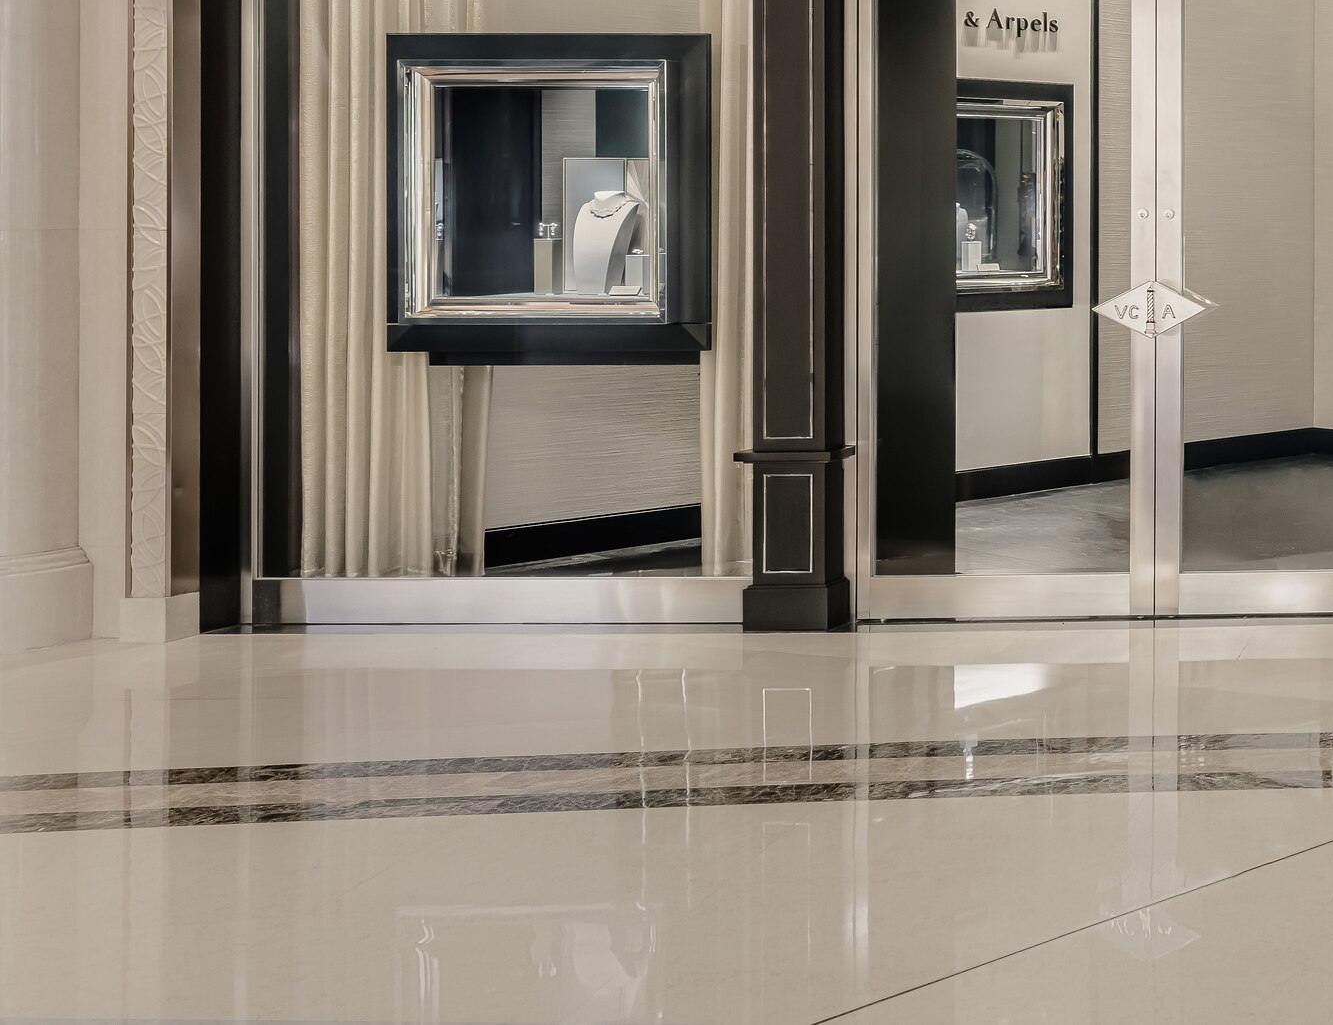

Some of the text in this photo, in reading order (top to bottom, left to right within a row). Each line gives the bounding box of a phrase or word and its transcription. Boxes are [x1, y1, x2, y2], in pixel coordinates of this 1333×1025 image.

[963, 8, 1059, 38] & Arpels
[1114, 304, 1177, 319] VC A
